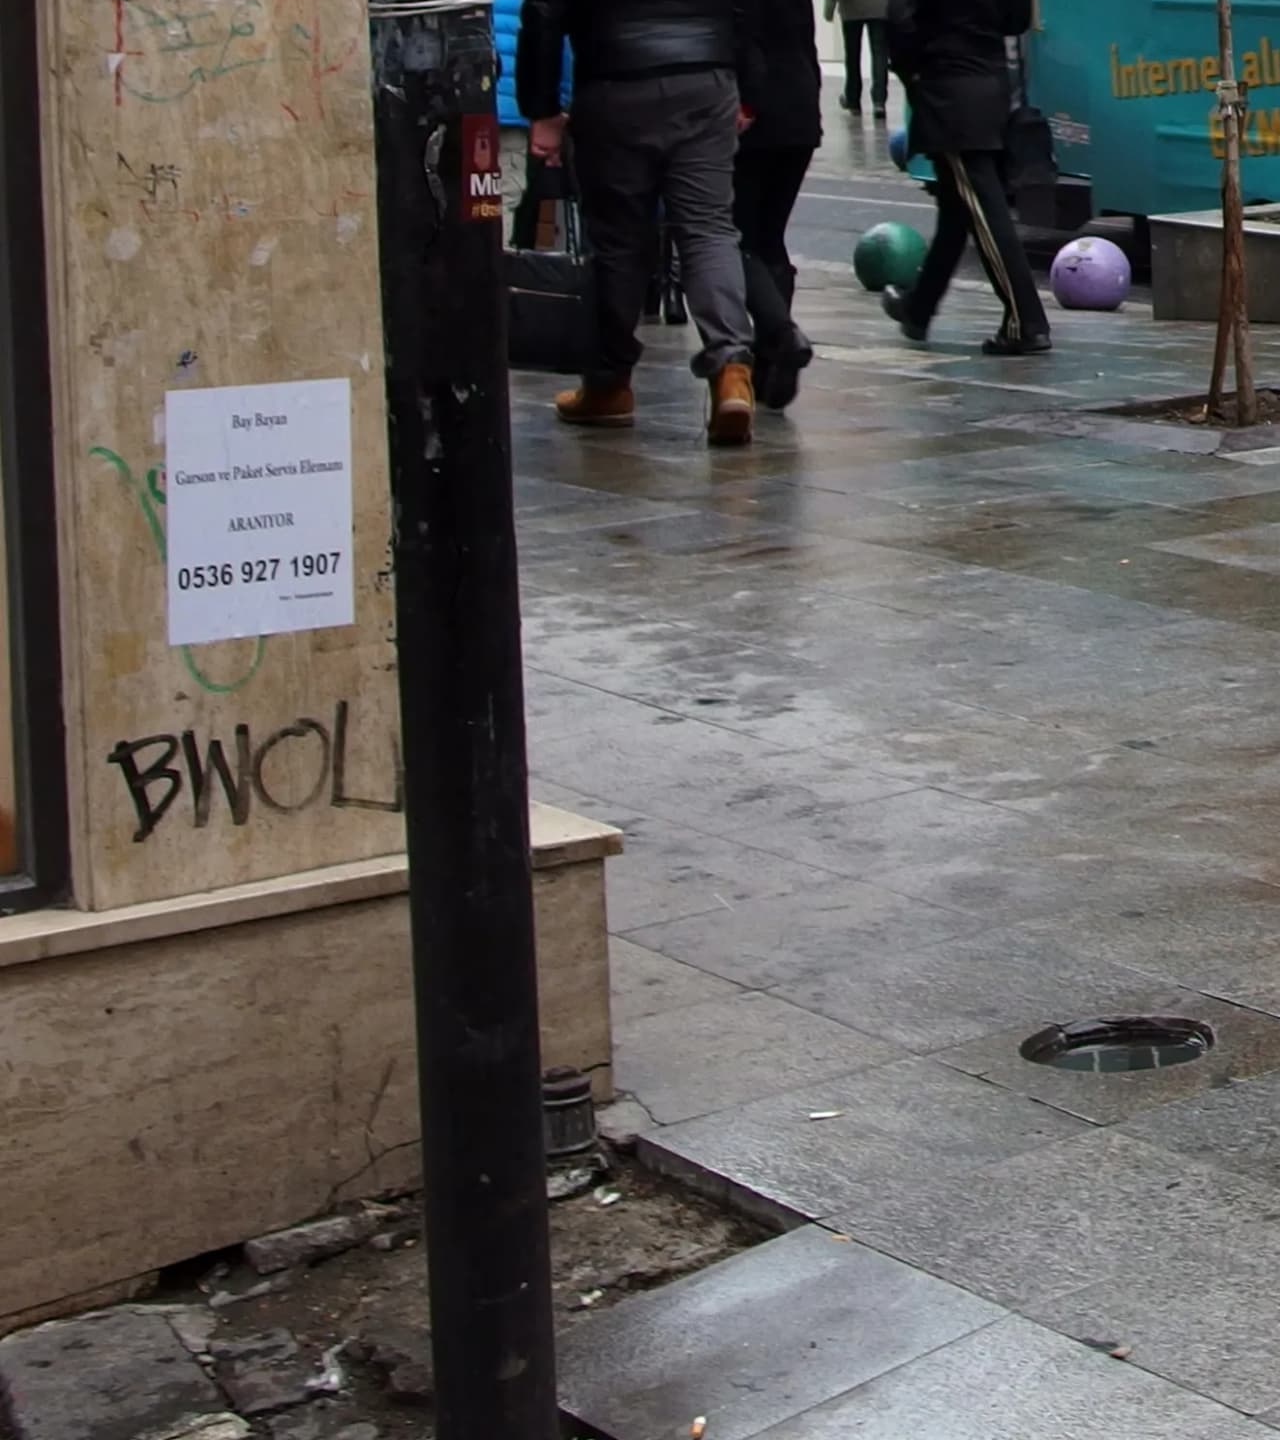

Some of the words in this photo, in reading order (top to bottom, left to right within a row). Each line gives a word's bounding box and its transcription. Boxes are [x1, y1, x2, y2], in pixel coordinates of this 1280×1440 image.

[1110, 42, 1222, 99] İnterne
[232, 414, 251, 431] Bay
[254, 412, 288, 430] Bayan
[175, 470, 215, 486] Garson
[218, 471, 230, 481] ve
[233, 465, 263, 482] Paket
[265, 462, 297, 478] Servis
[228, 512, 294, 533] ARANIYOR
[178, 563, 233, 590] 0536
[241, 558, 281, 584] 927
[290, 551, 341, 578] 1907
